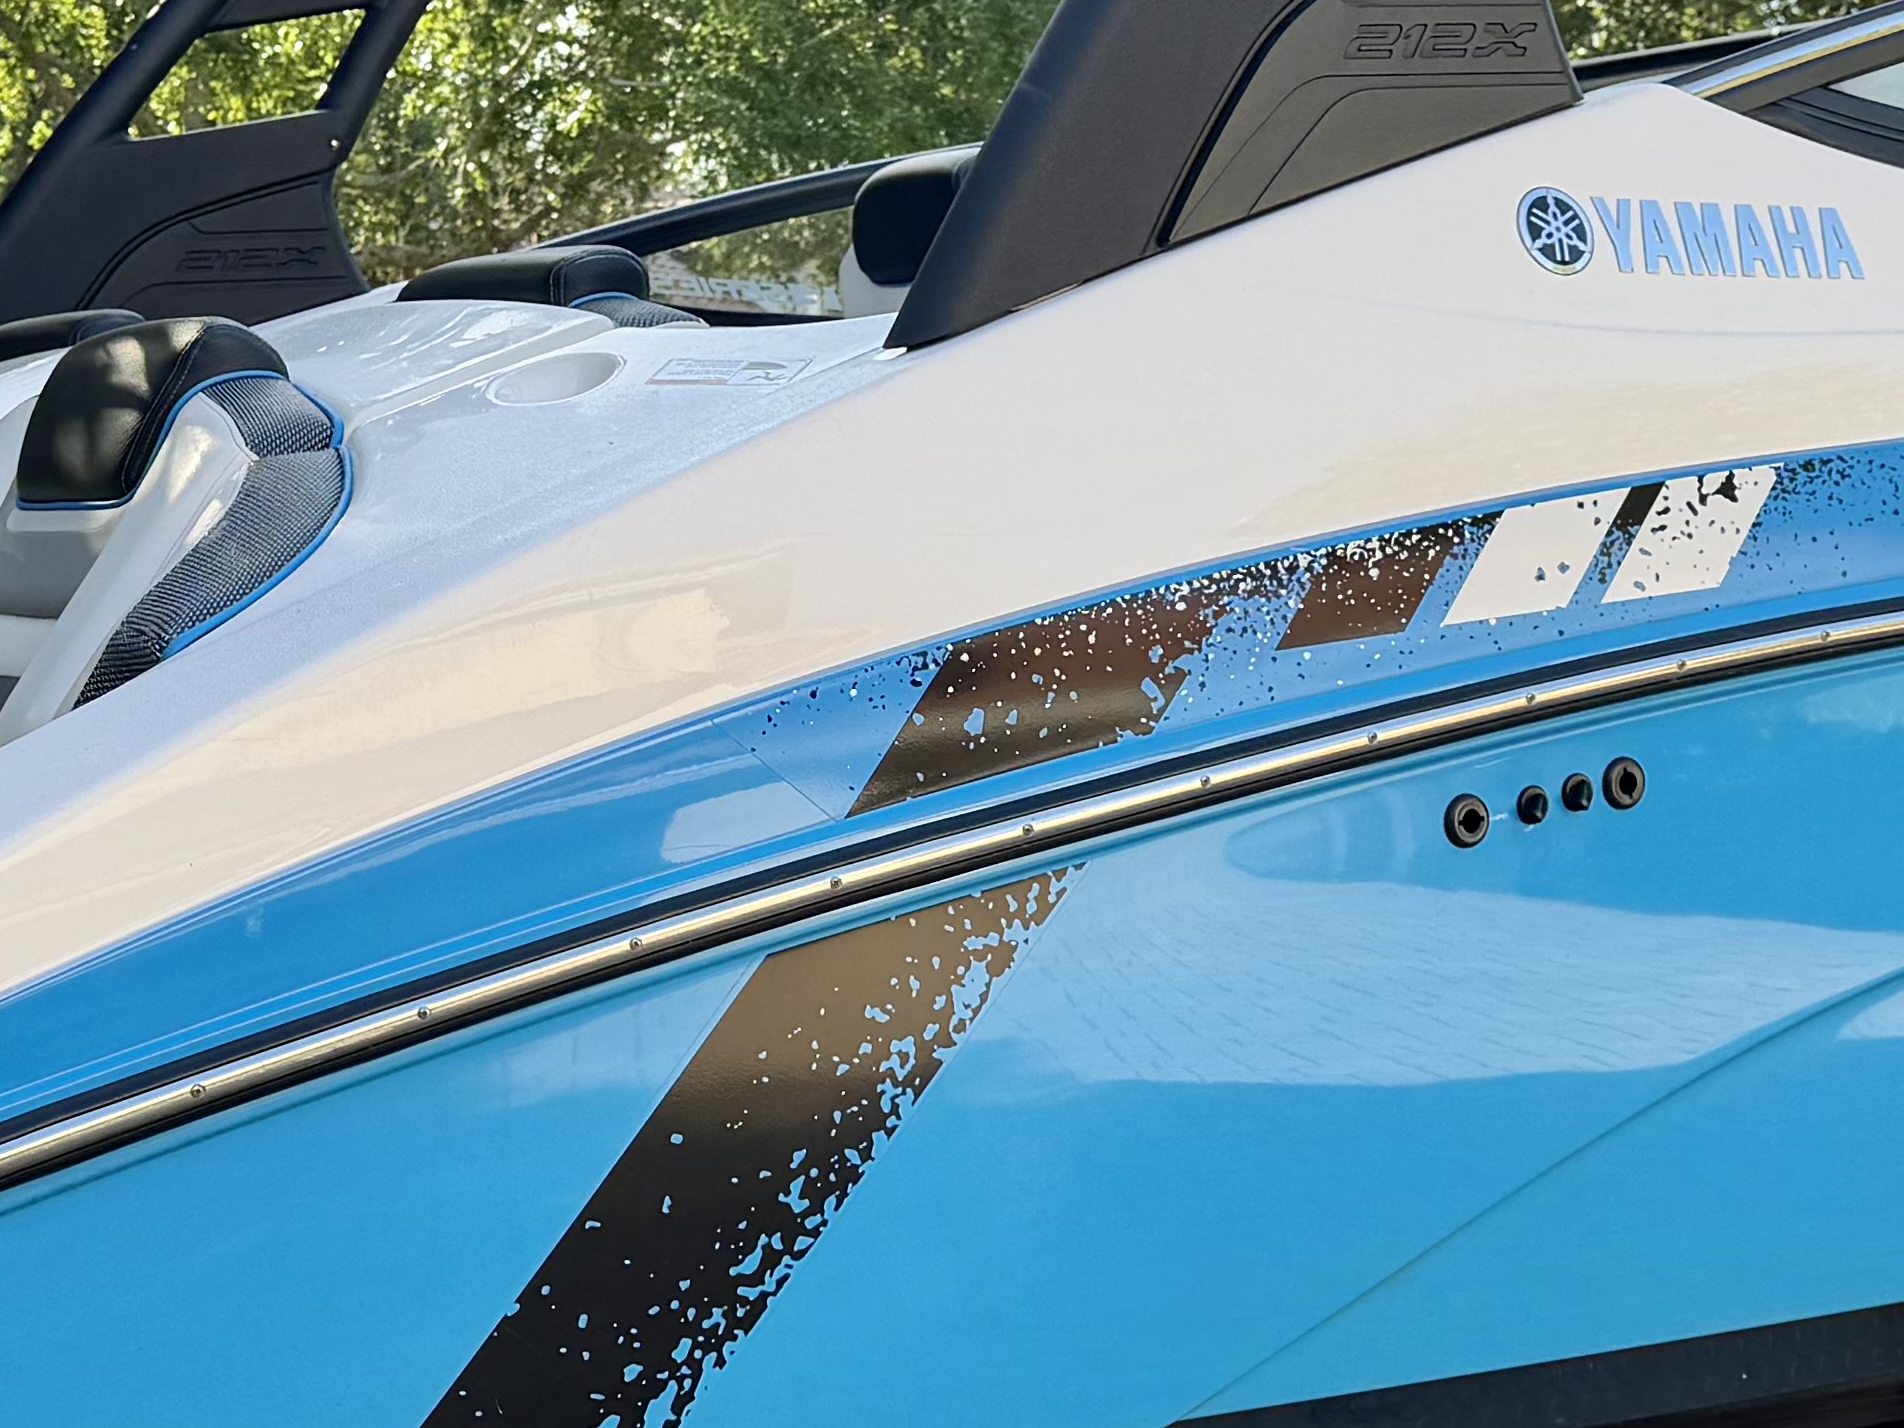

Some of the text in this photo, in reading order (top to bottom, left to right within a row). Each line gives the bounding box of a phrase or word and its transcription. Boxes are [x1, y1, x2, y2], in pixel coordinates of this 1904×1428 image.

[1343, 22, 1538, 60] 212X
[1589, 195, 1866, 279] YAMAHA
[176, 245, 327, 273] 212X
